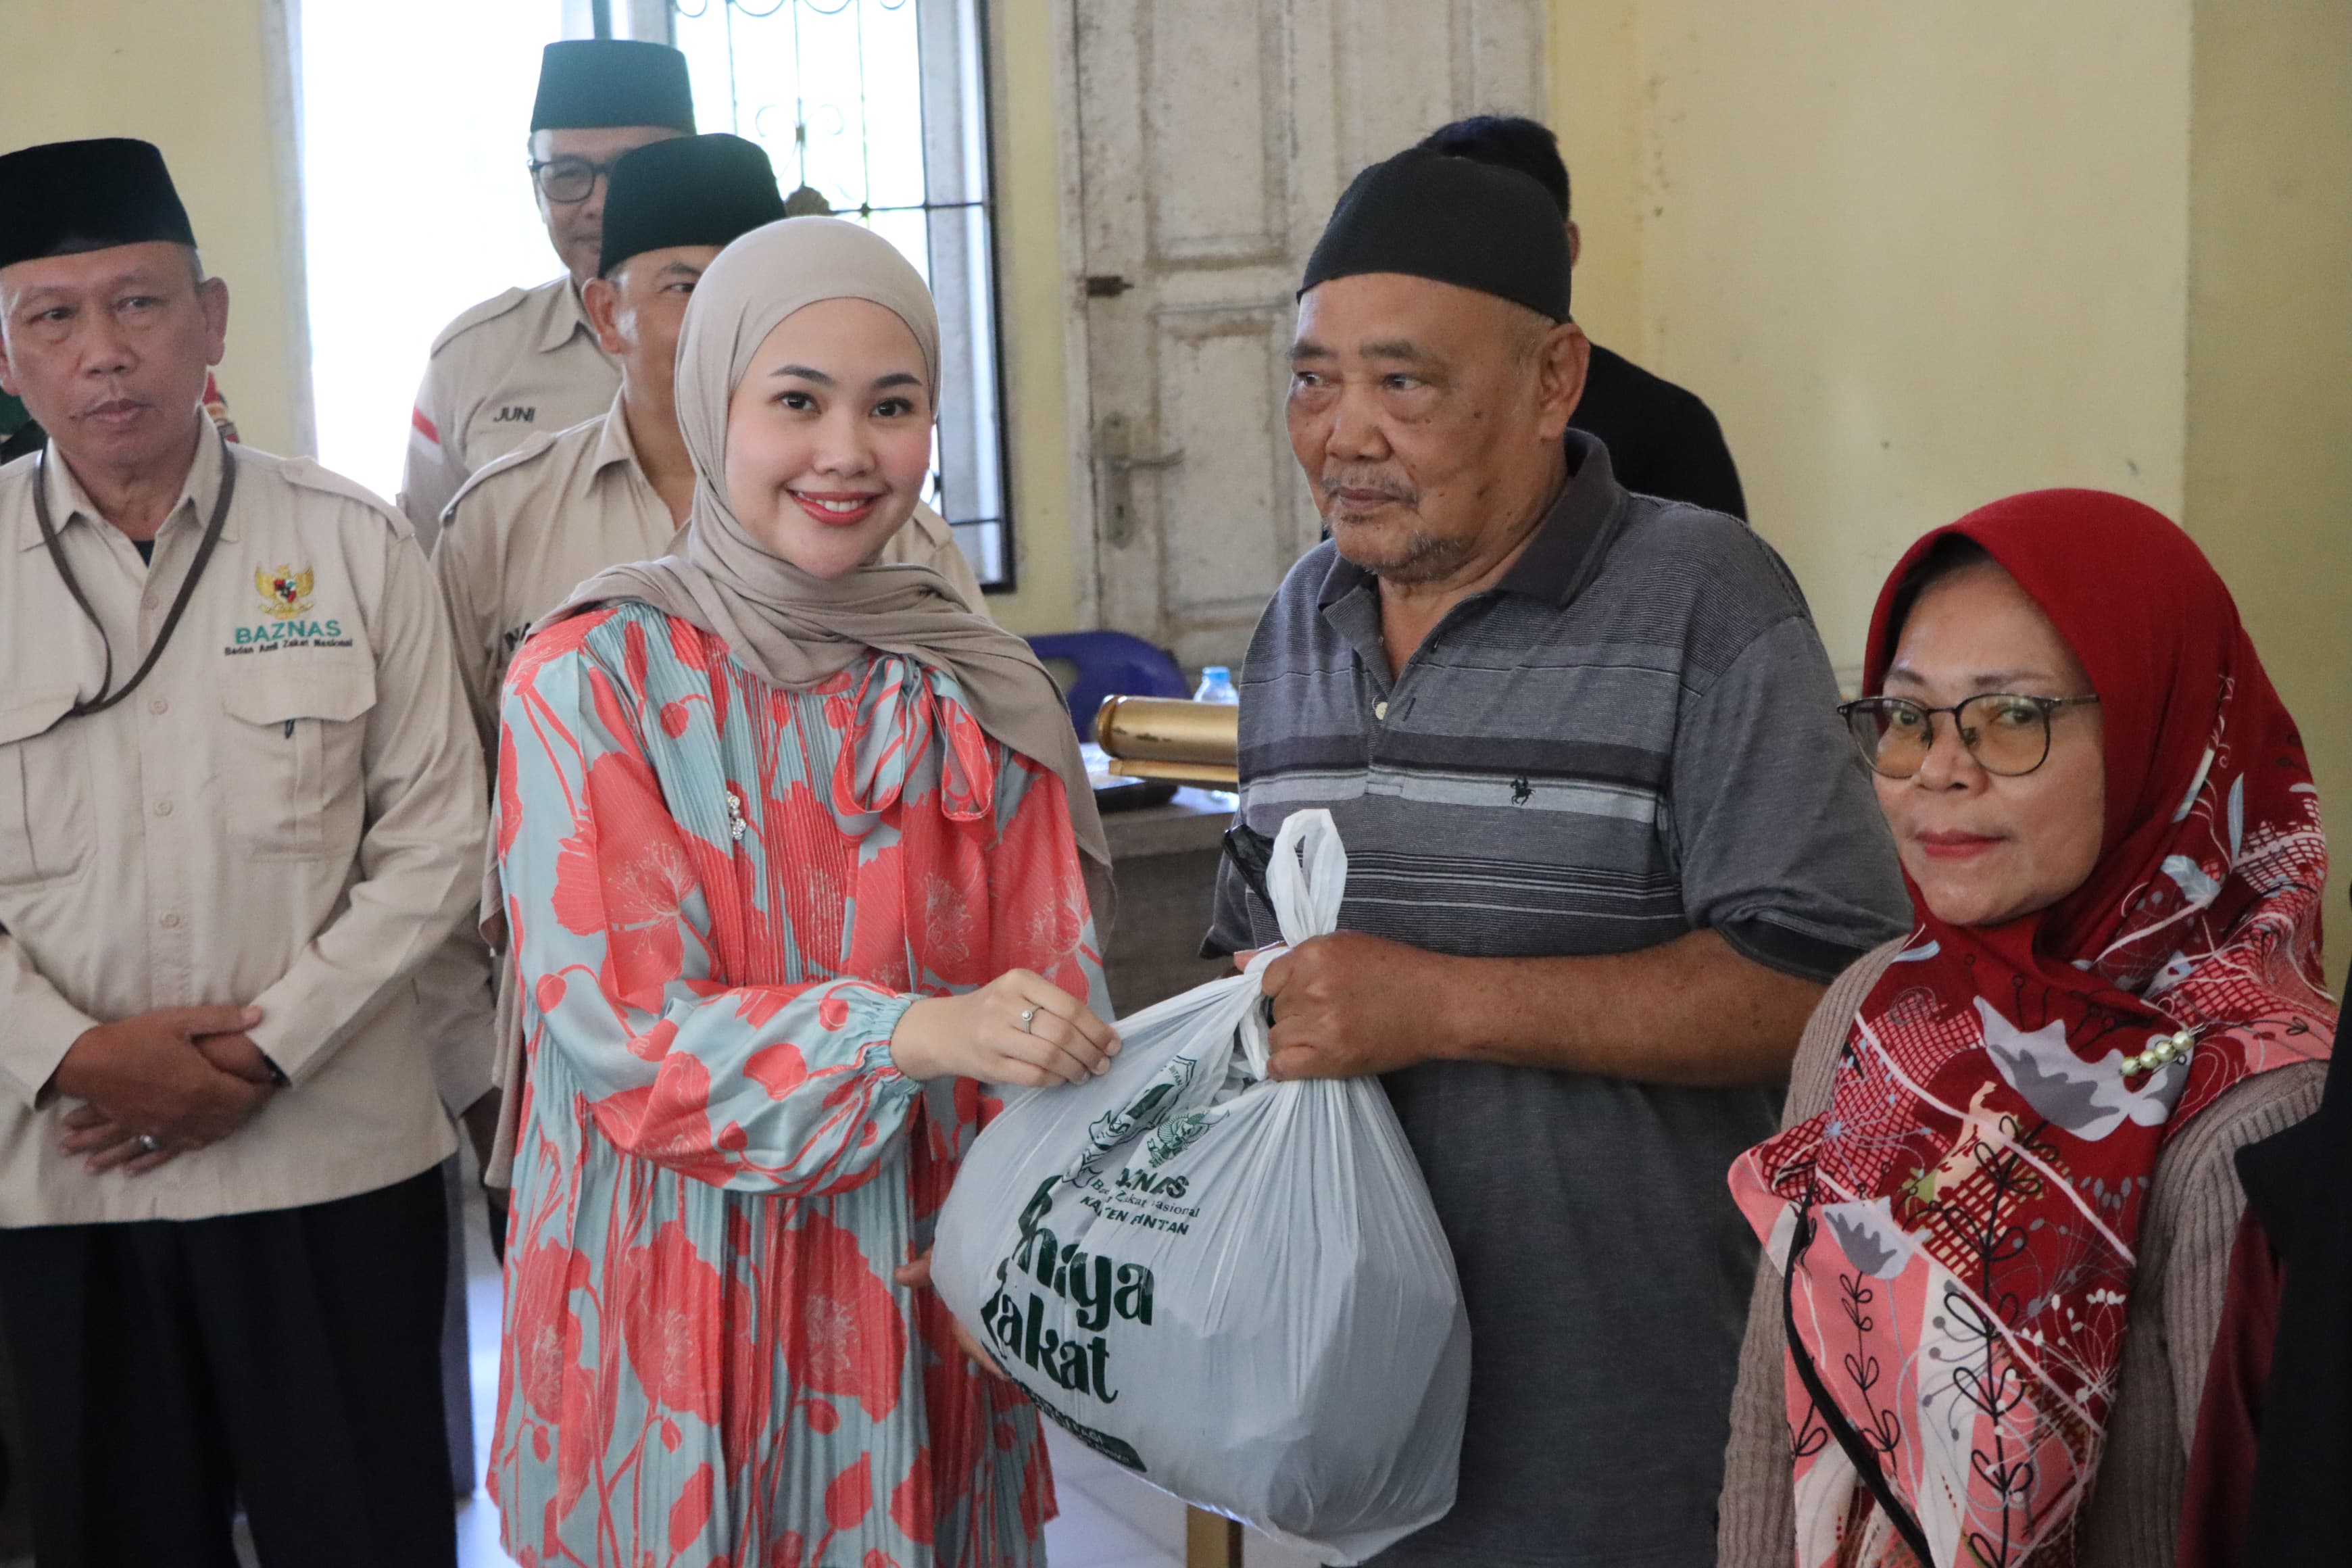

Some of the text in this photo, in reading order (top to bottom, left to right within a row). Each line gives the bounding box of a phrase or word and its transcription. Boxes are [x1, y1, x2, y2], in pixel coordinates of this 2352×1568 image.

[493, 407, 536, 422] JUNI
[235, 620, 342, 644] BAZNAS
[224, 647, 253, 656] Badan
[1151, 1200, 1200, 1217] asional
